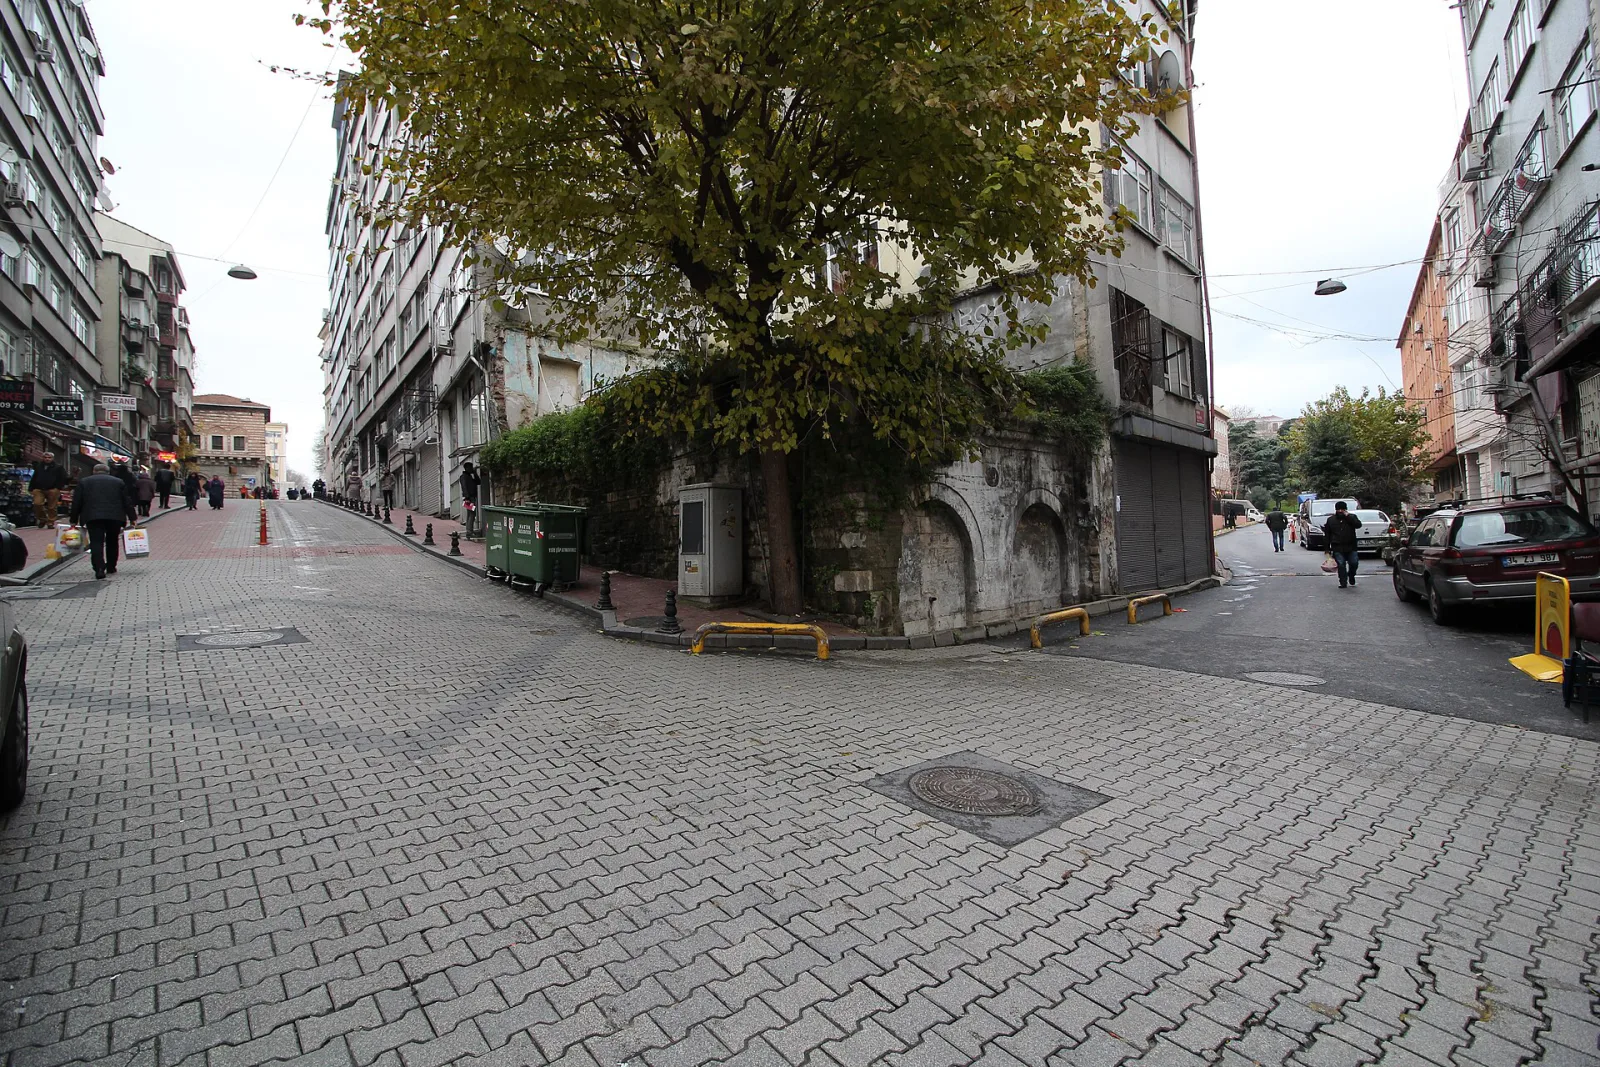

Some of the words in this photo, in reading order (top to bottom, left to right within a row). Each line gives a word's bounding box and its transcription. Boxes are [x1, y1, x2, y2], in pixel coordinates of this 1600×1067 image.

[103, 397, 136, 405] ECZANE
[1508, 556, 1518, 564] 34
[1523, 555, 1535, 563] ZJ
[1540, 553, 1556, 562] 987
